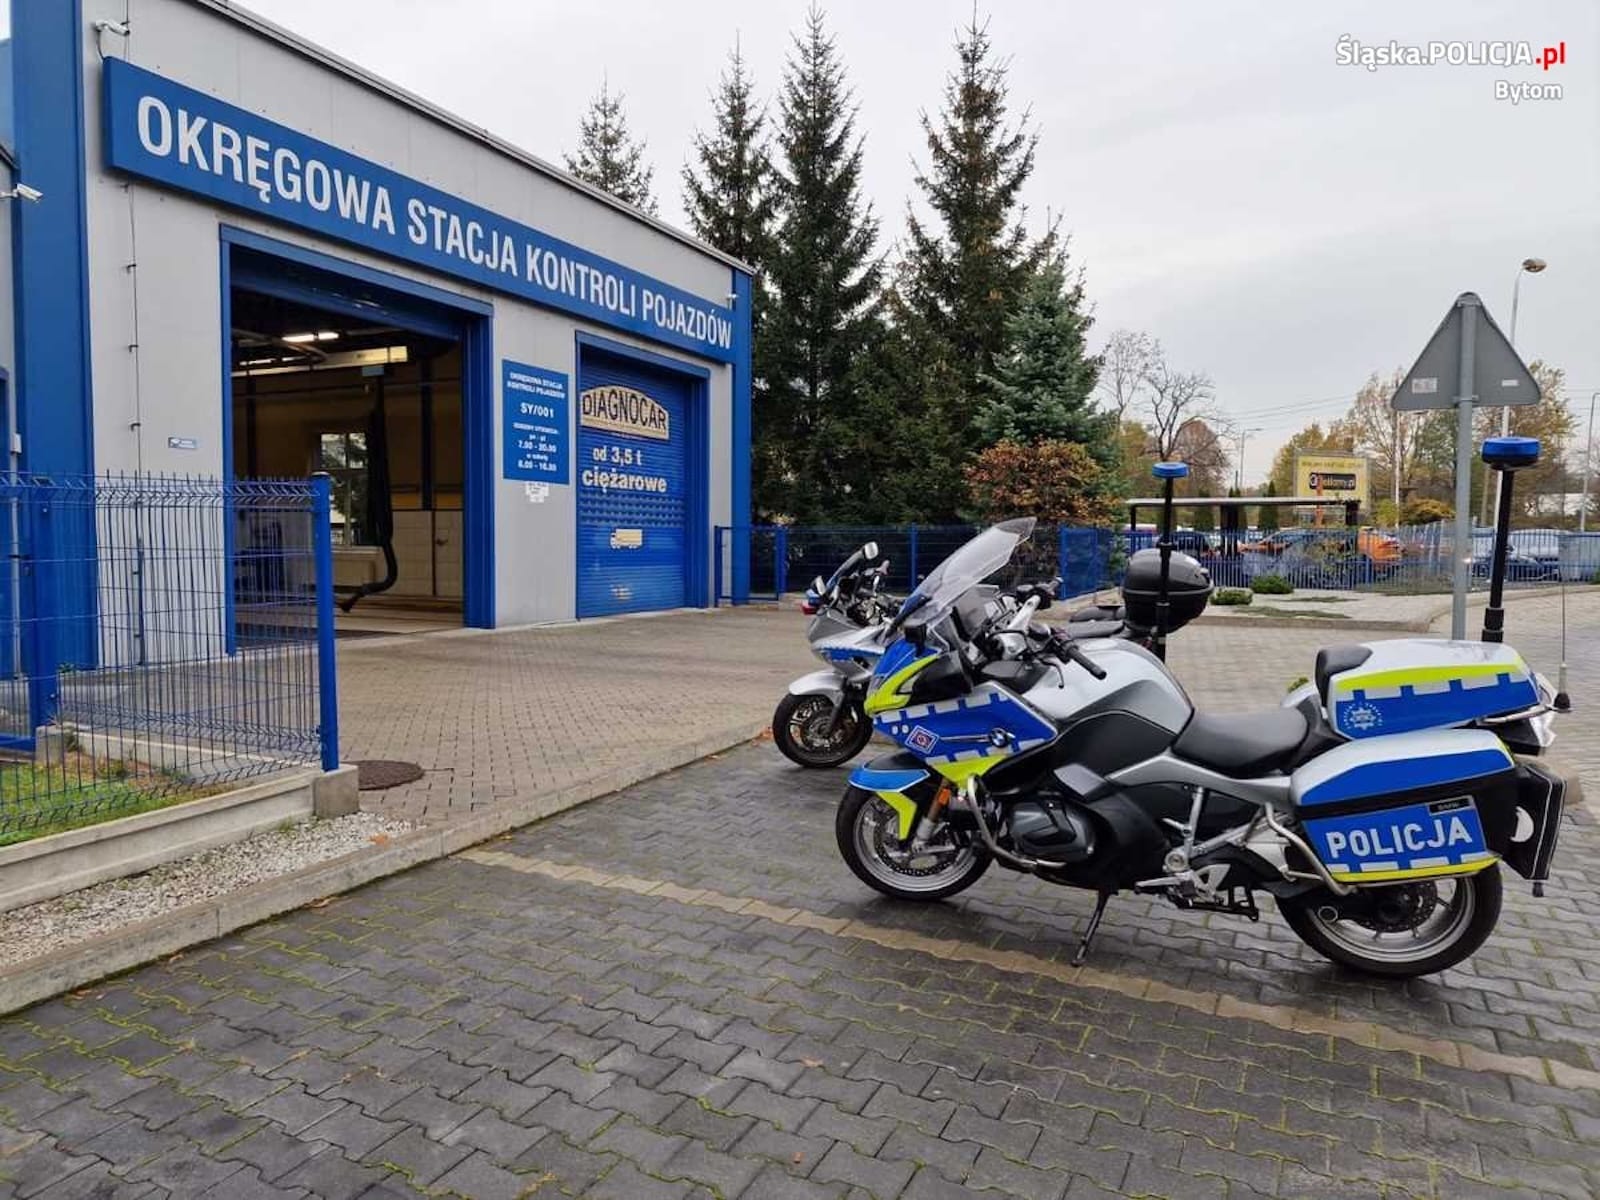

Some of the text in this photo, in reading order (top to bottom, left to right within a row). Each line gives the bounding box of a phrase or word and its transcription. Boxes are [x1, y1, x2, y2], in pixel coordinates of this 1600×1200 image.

[137, 96, 732, 350] OKRĘGOWA STACJA KONTROLI POJAZDÓW
[520, 402, 554, 418] SY/001
[582, 388, 667, 430] DIAGNOCAR
[593, 445, 642, 466] od 3,5 t
[582, 466, 667, 493] ciężarowe
[1325, 816, 1472, 859] POLICJA
